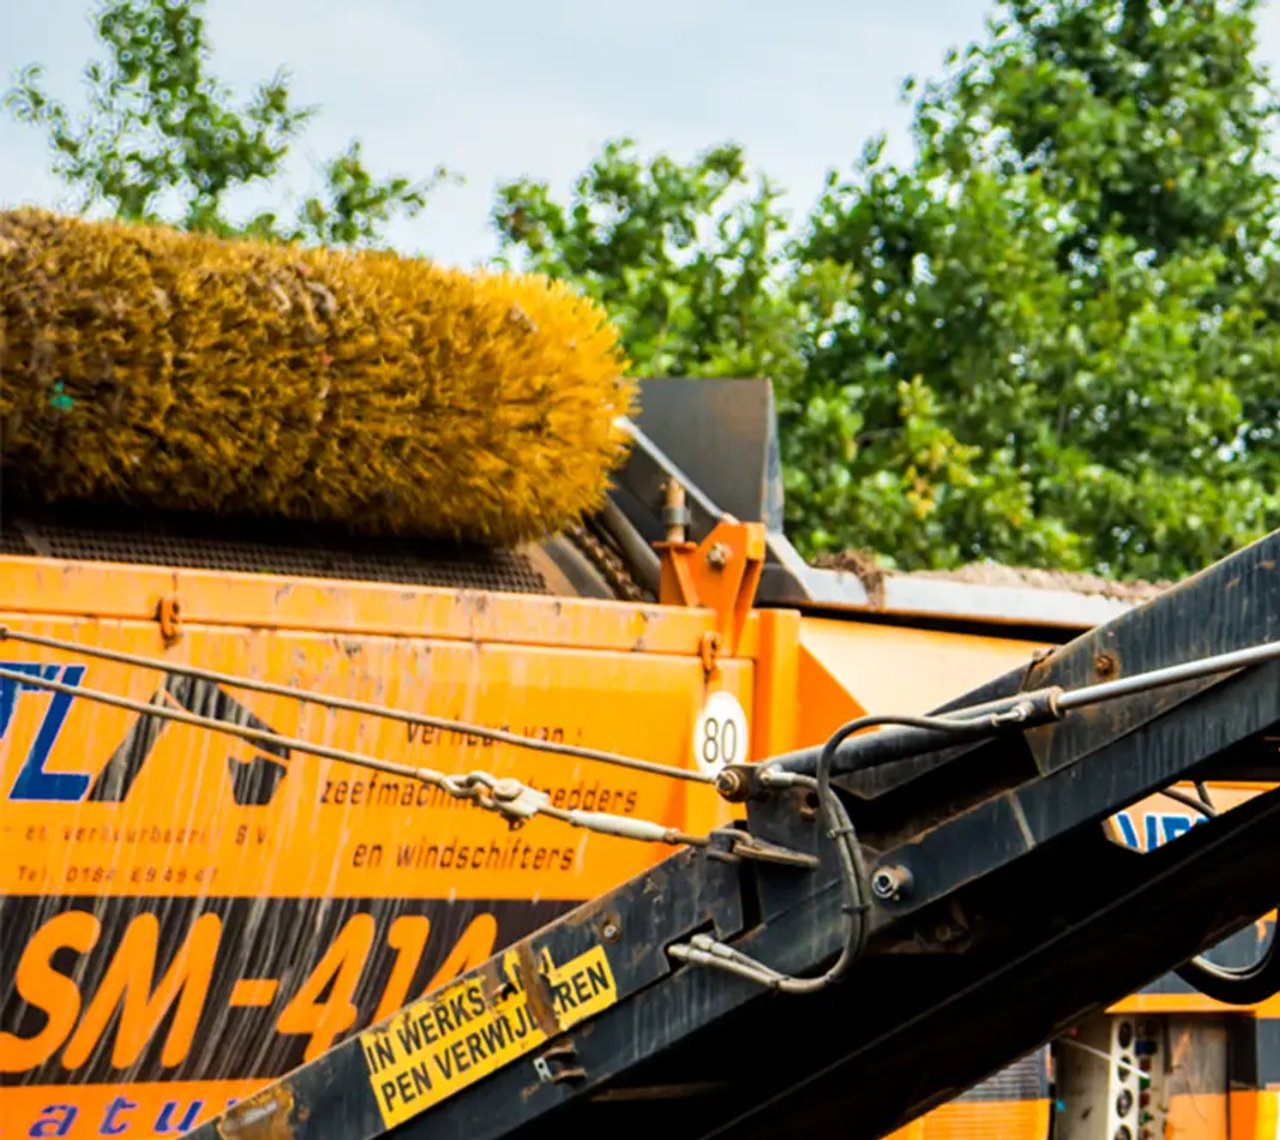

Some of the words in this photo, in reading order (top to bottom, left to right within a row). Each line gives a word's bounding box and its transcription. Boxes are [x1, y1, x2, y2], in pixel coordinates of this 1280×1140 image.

[703, 717, 737, 764] 80
[353, 843, 382, 867] en
[396, 837, 574, 870] windschifters
[367, 1036, 396, 1074] IN
[381, 1062, 433, 1112] PEN
[434, 961, 610, 1080] VERWIJREN
